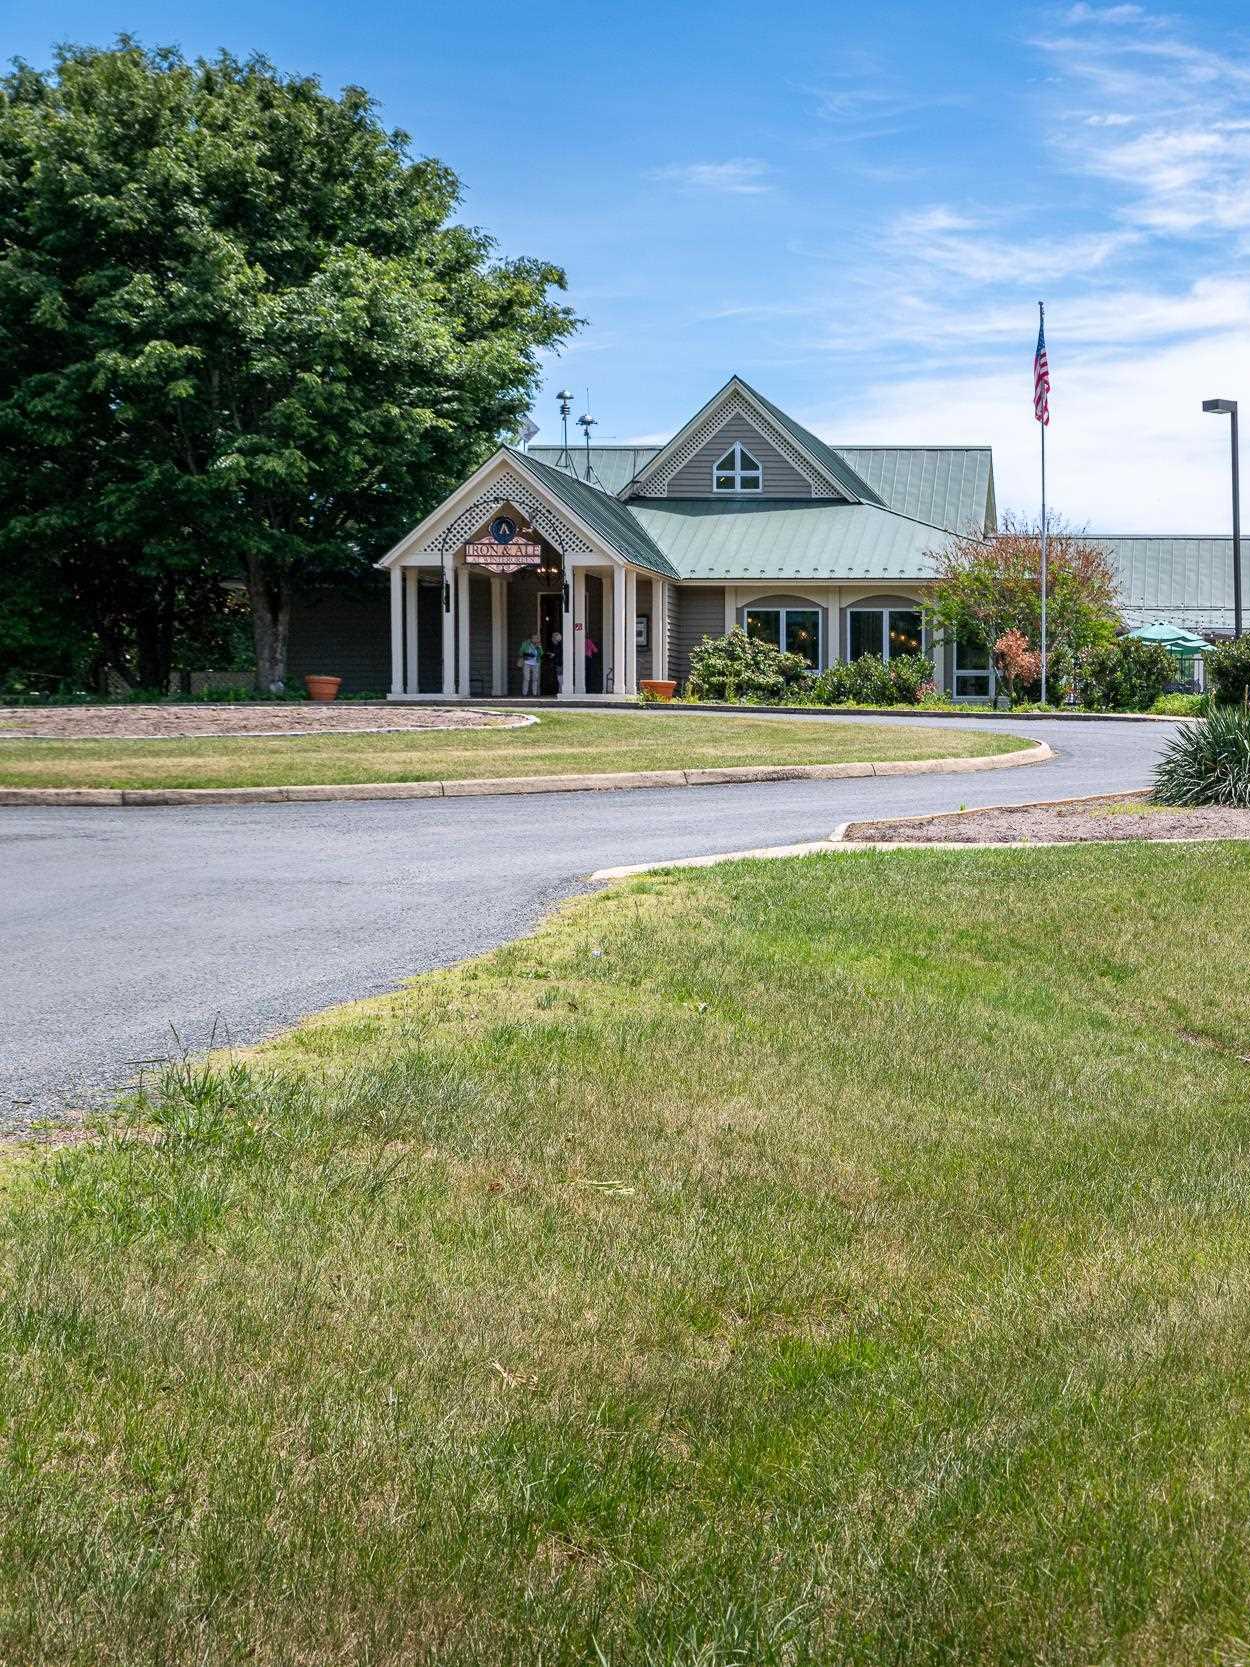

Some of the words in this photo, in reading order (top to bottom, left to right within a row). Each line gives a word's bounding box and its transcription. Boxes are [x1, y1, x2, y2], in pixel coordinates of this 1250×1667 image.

[466, 544, 499, 556] IRON
[502, 544, 511, 556] &
[515, 544, 541, 556] ALE
